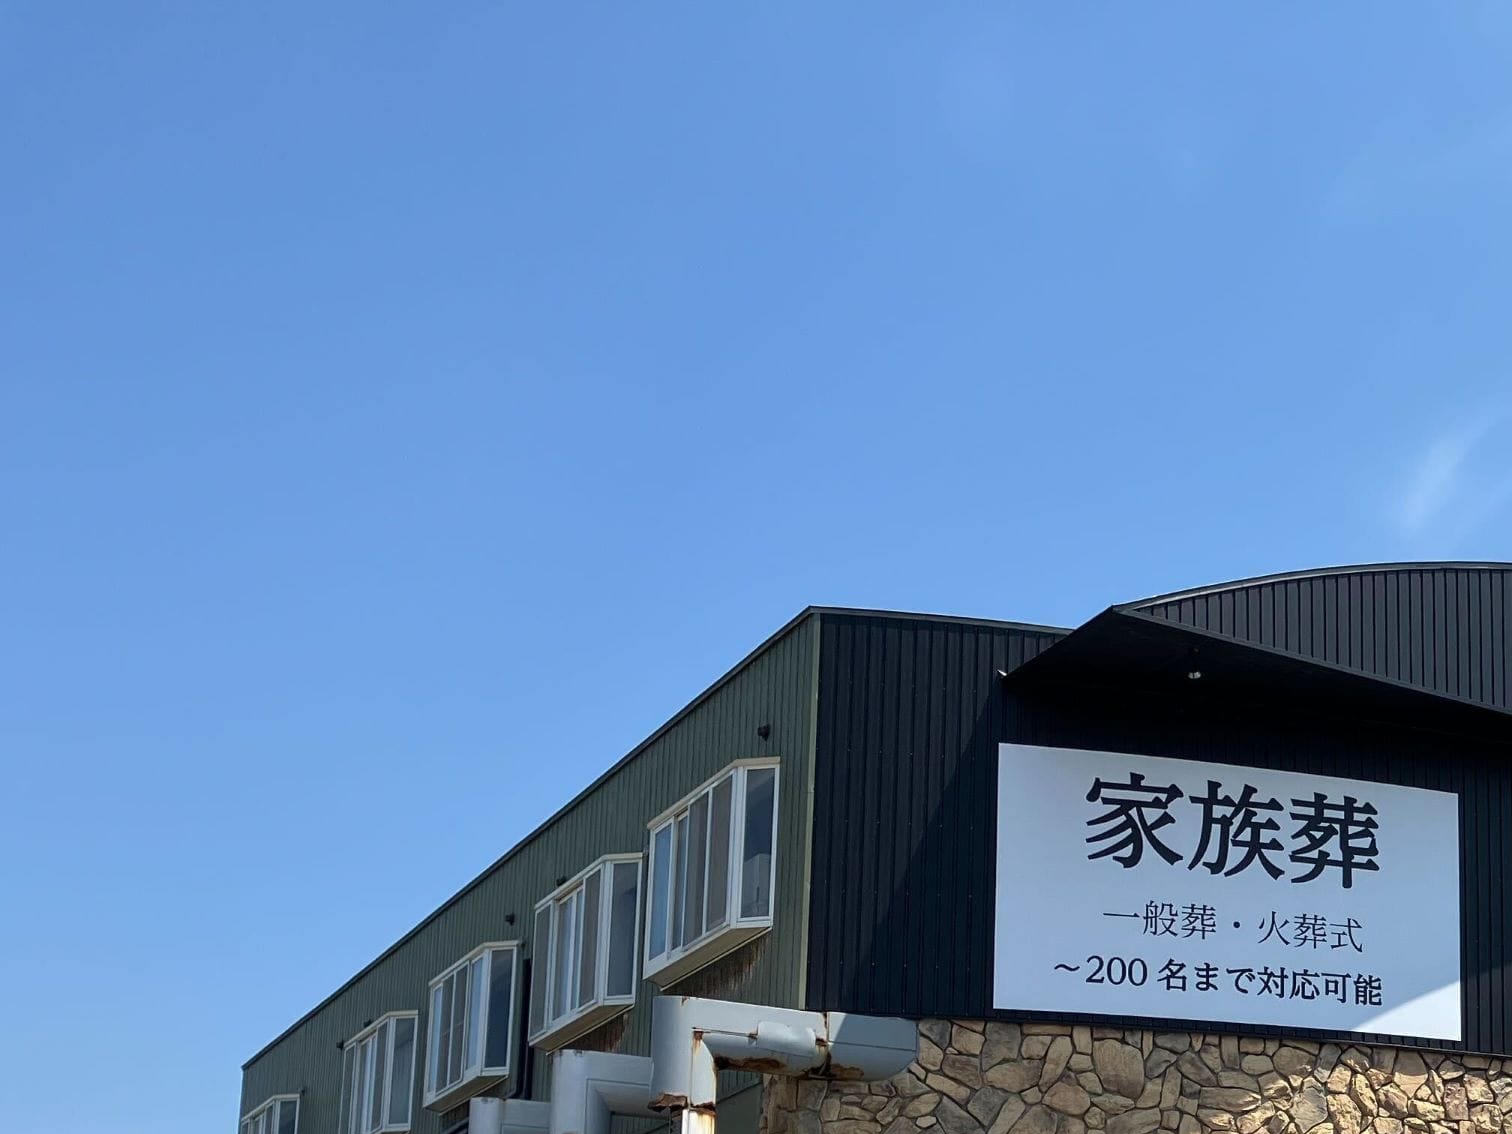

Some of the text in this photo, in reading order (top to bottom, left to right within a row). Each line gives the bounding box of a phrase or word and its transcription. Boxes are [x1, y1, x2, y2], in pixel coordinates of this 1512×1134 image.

[1085, 772, 1379, 889] 家族葬
[1102, 900, 1364, 952] 一般葬・火葬式
